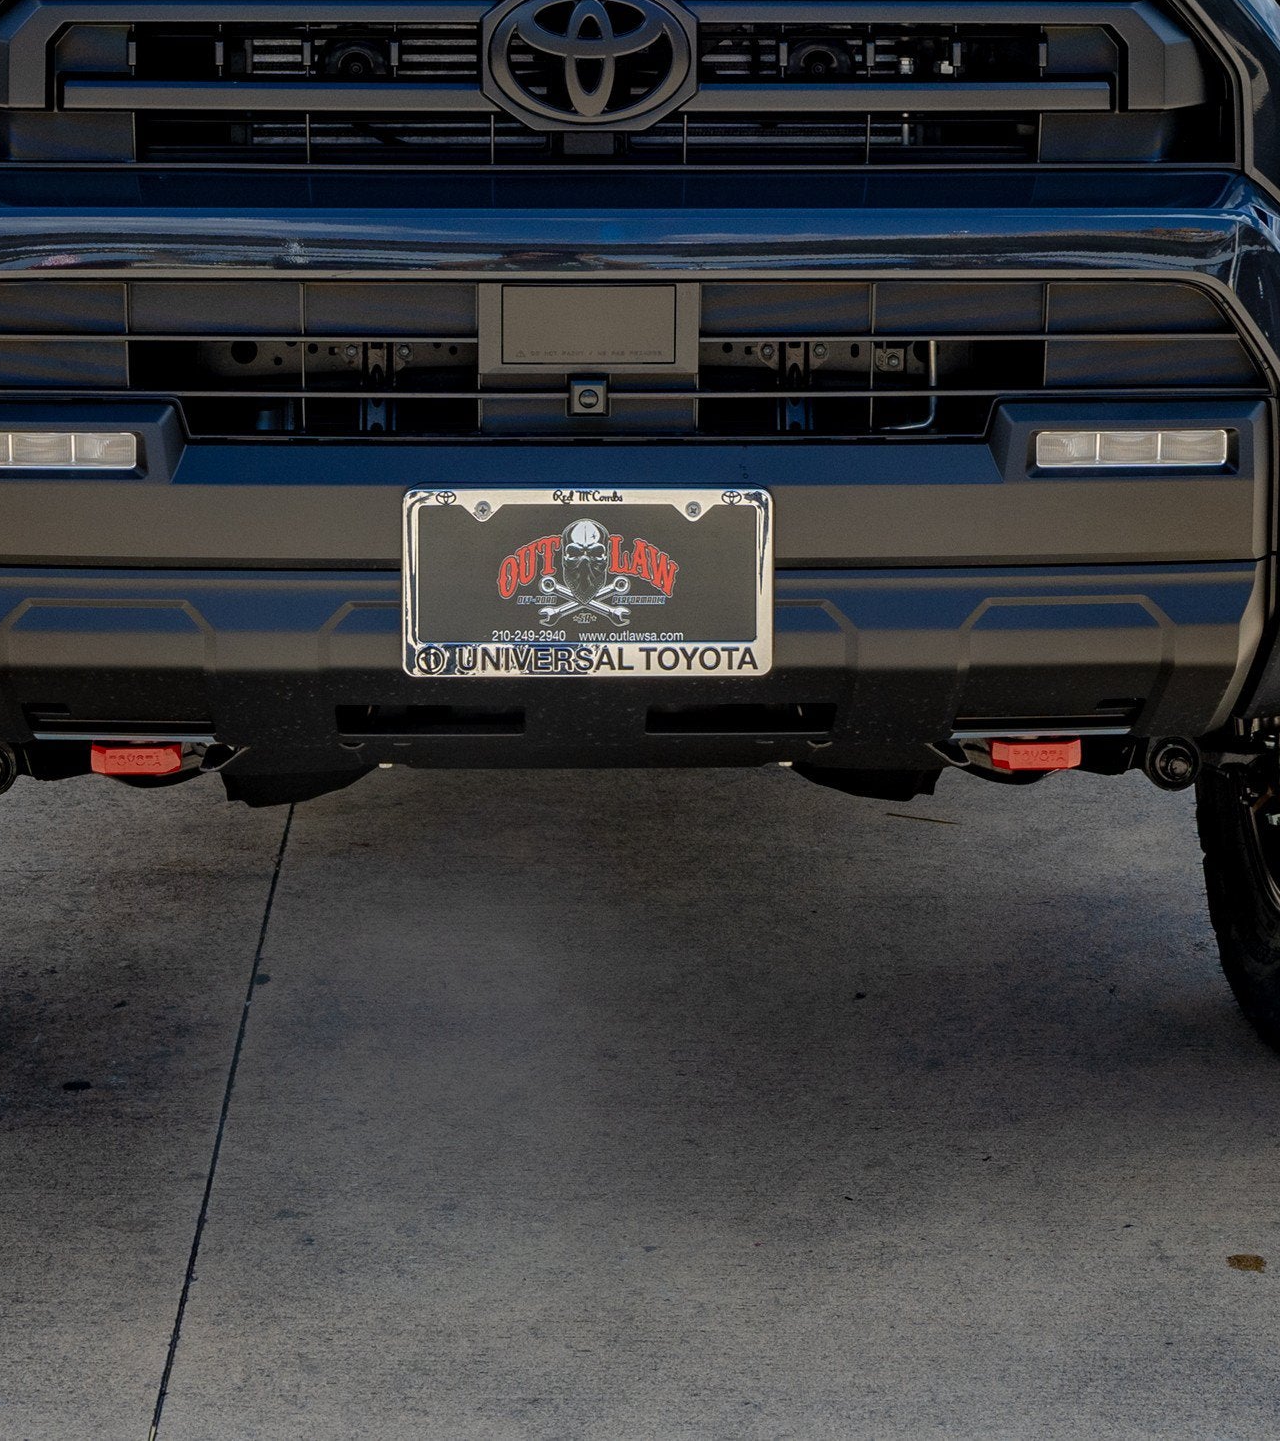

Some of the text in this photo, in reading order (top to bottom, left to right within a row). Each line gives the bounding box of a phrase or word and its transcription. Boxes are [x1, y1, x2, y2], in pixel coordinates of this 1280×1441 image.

[552, 489, 574, 504] Red
[491, 629, 684, 642] 210-249-2940 www.outlawsa.com
[457, 645, 759, 672] UNIVERSAL TOYOTA
